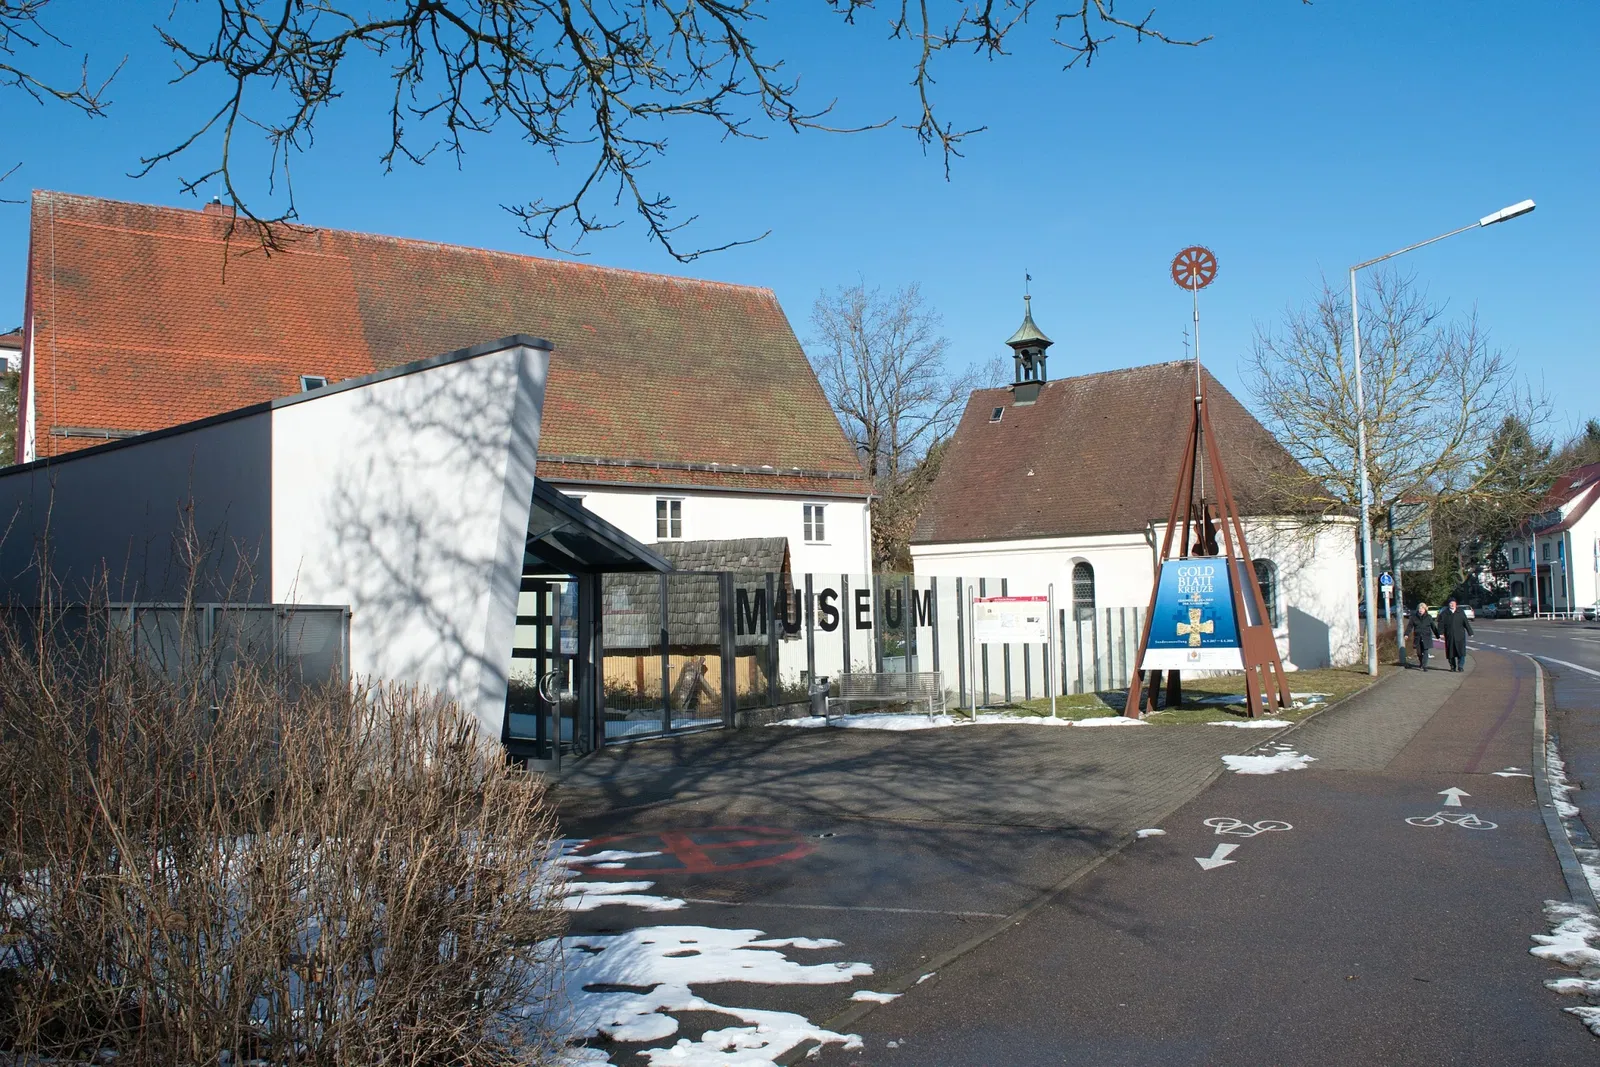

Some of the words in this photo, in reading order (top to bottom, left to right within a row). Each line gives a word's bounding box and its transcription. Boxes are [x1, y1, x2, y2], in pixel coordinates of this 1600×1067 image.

[1178, 566, 1215, 577] GOLD
[1178, 576, 1215, 586] BLATT
[1178, 585, 1214, 593] KREUZE
[736, 587, 932, 636] MUSEUM
